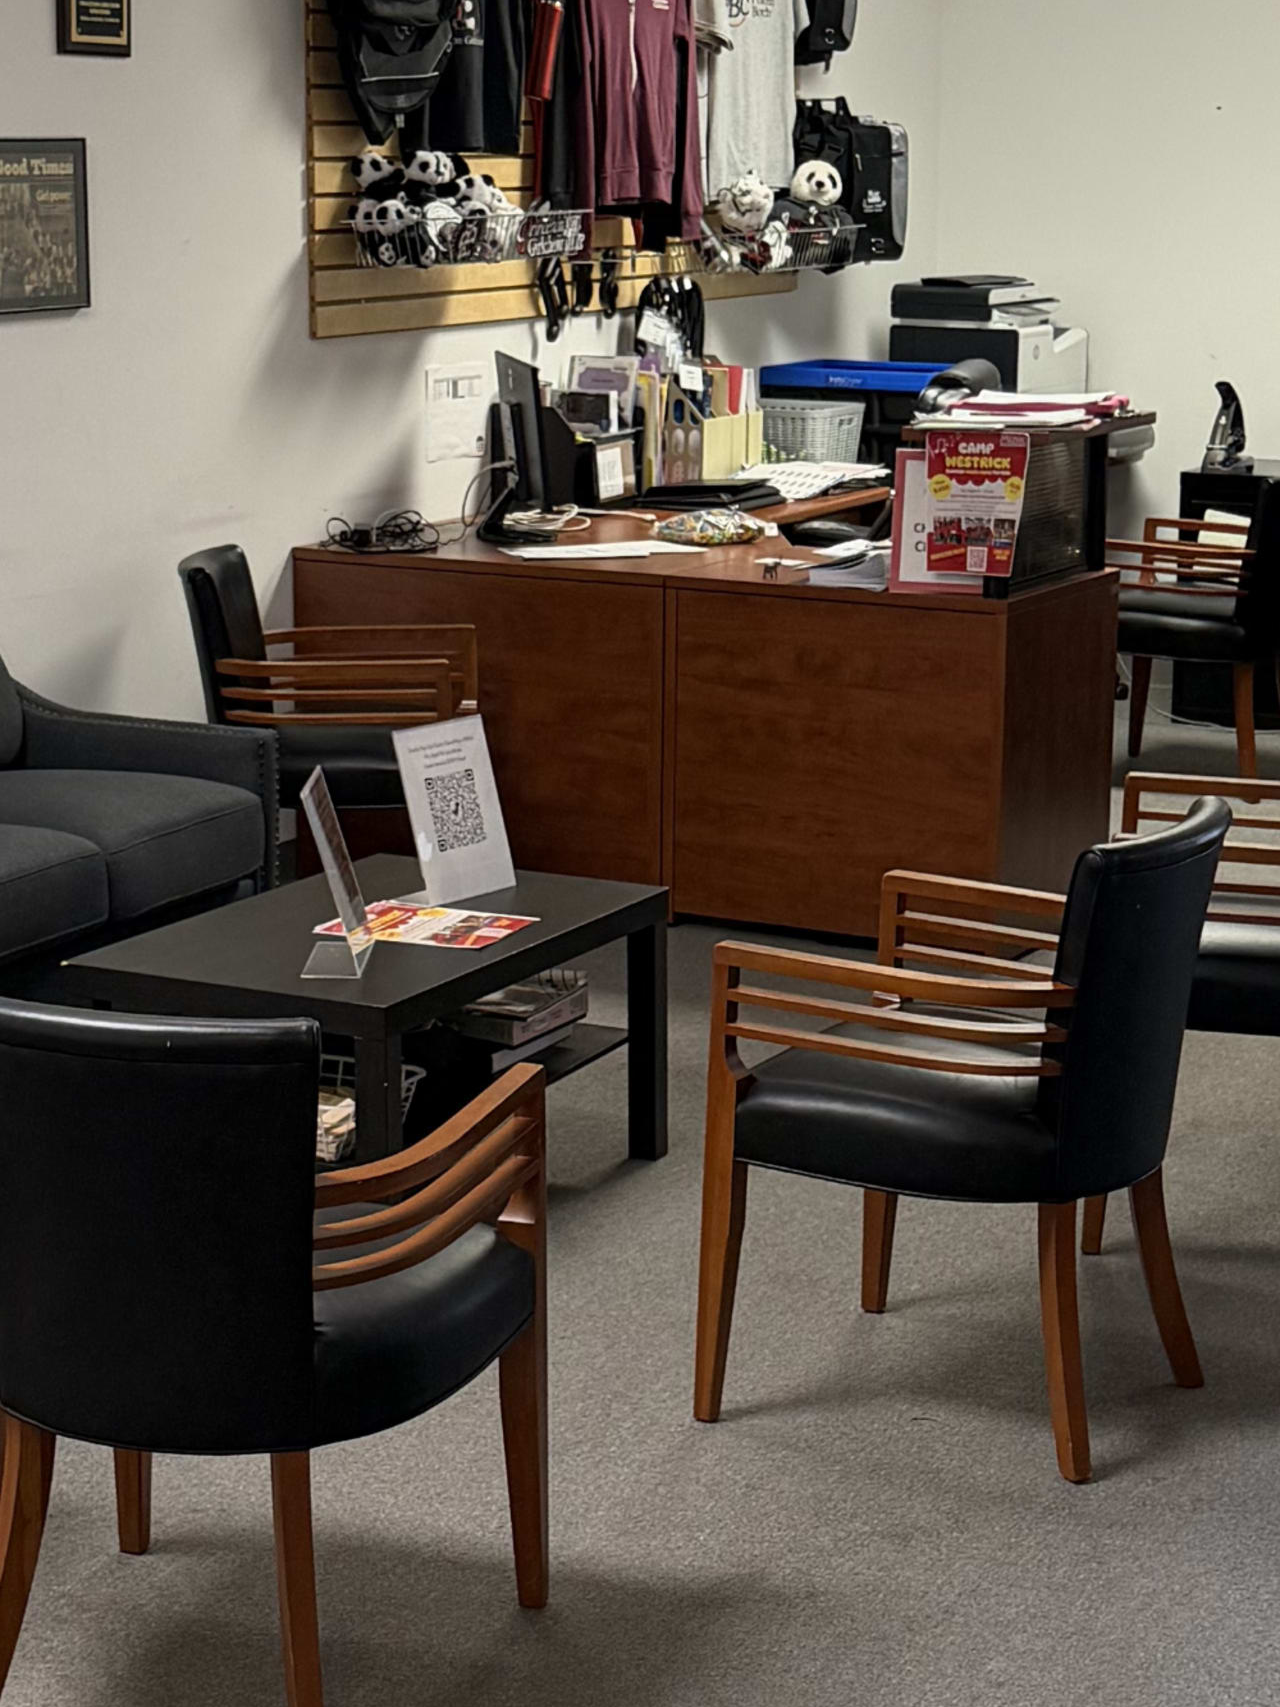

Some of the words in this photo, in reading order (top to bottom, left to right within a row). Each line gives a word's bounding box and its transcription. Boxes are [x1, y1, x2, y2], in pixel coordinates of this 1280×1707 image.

[30, 157, 74, 175] Times
[957, 442, 995, 454] CAMP
[944, 455, 1011, 469] WESTRICK
